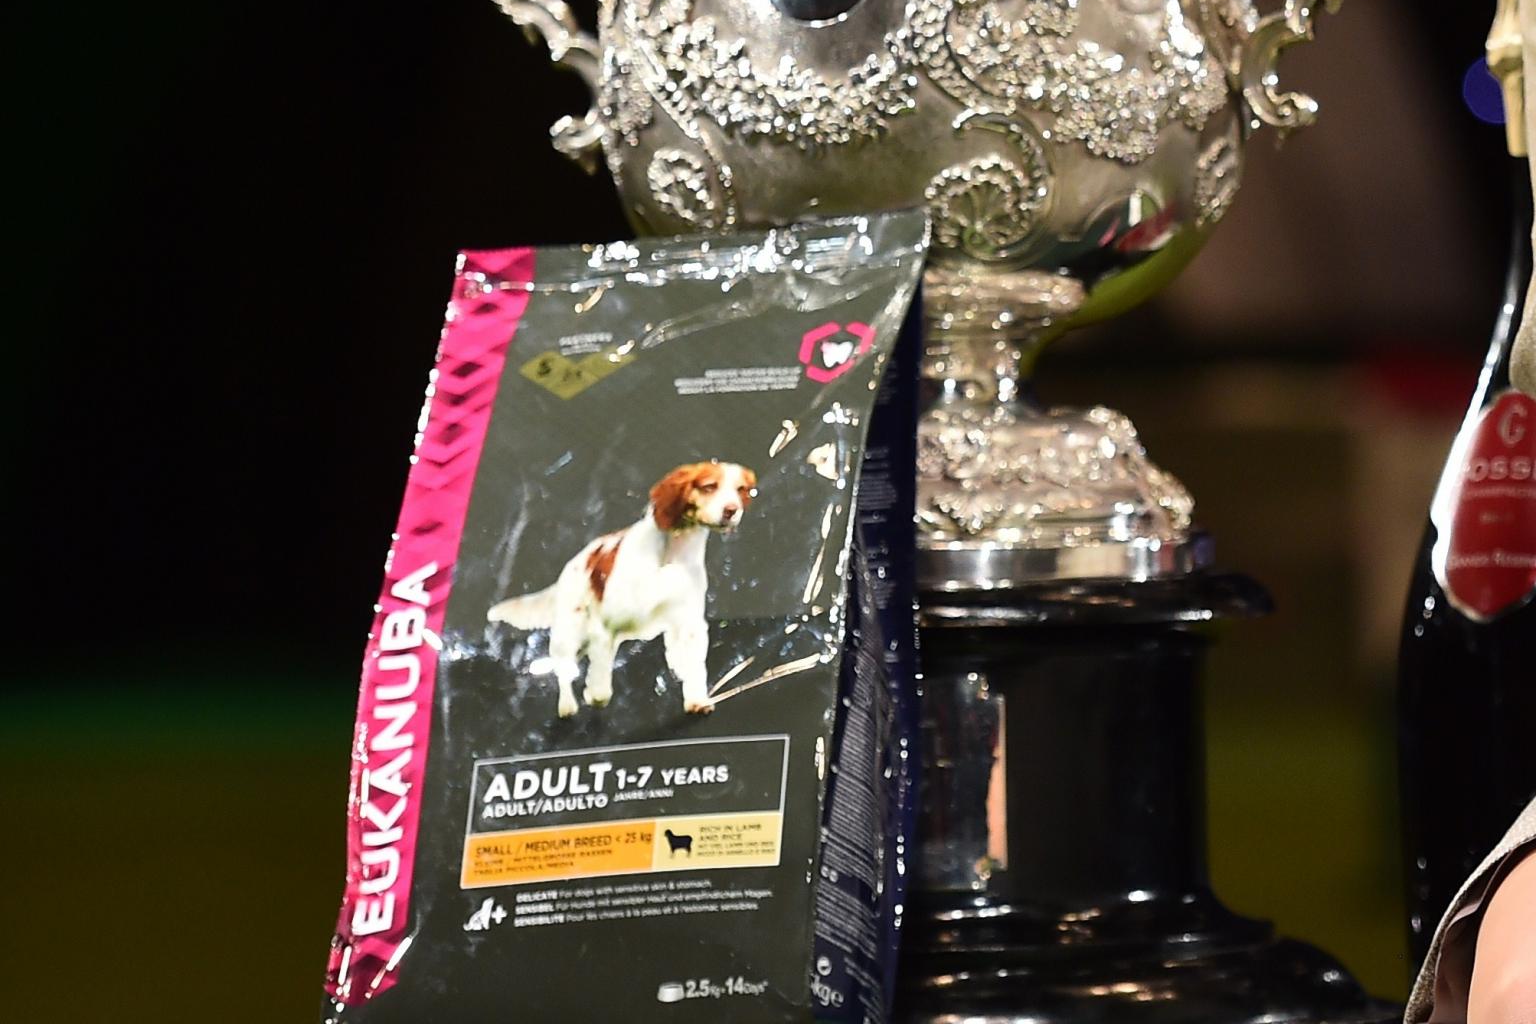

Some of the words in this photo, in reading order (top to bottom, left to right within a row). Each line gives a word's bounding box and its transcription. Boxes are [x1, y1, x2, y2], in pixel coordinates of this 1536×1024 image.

[352, 560, 439, 936] EUKANUBA
[483, 761, 613, 803] ADULT
[615, 766, 653, 790] 1-7
[661, 764, 730, 787] YEARS
[482, 793, 609, 819] ADULT/ADULTO
[476, 844, 512, 859] SMALL
[525, 838, 570, 853] MEDIUM
[574, 835, 612, 848] BREED
[625, 832, 639, 844] 25
